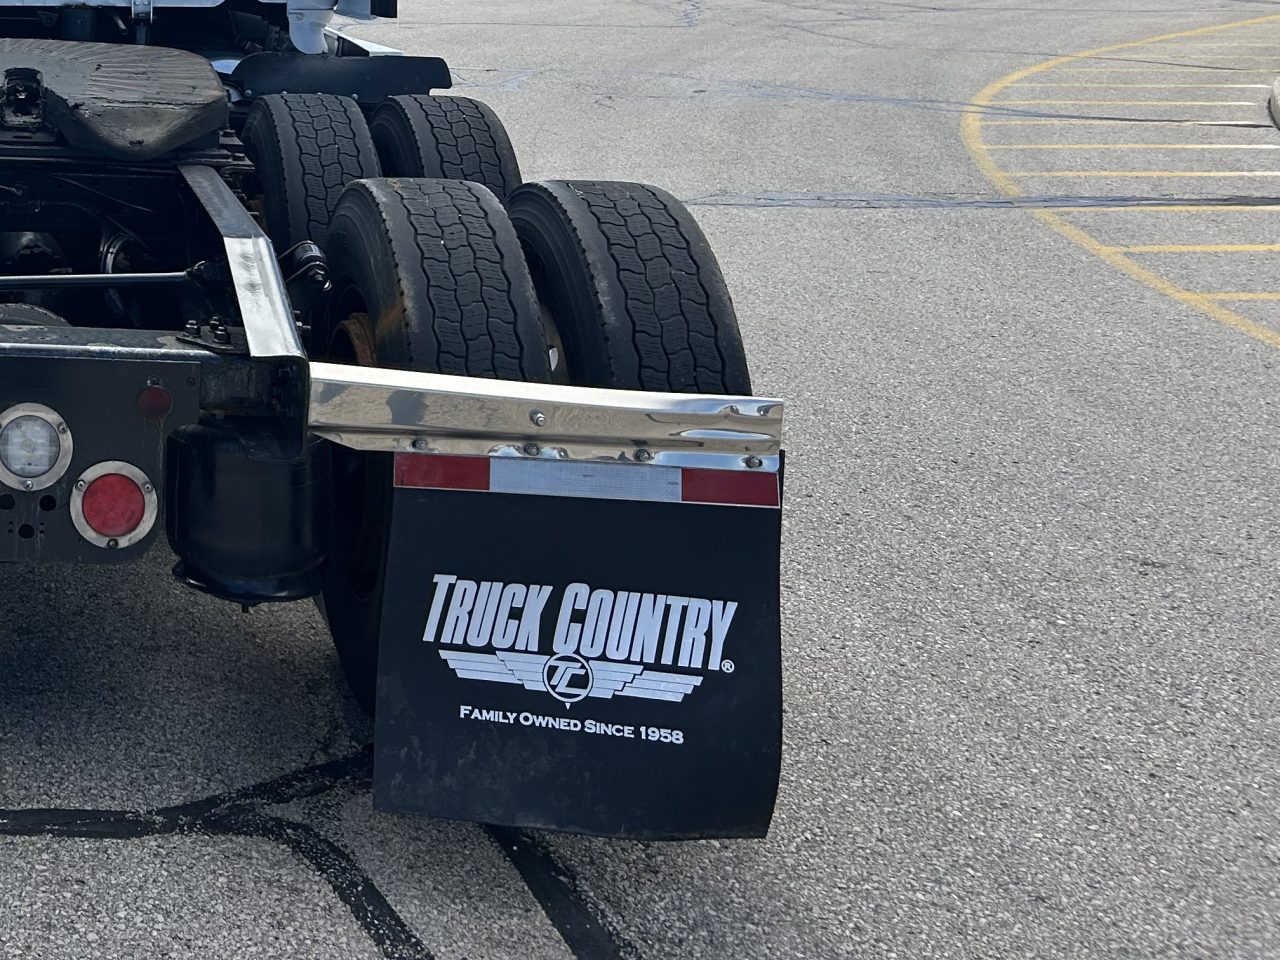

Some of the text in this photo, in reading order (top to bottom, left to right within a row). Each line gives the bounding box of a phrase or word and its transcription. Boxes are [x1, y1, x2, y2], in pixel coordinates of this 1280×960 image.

[422, 573, 739, 671] TRUCK COUNTRY
[459, 705, 684, 745] FAMILY OWNED SINCE 1958
